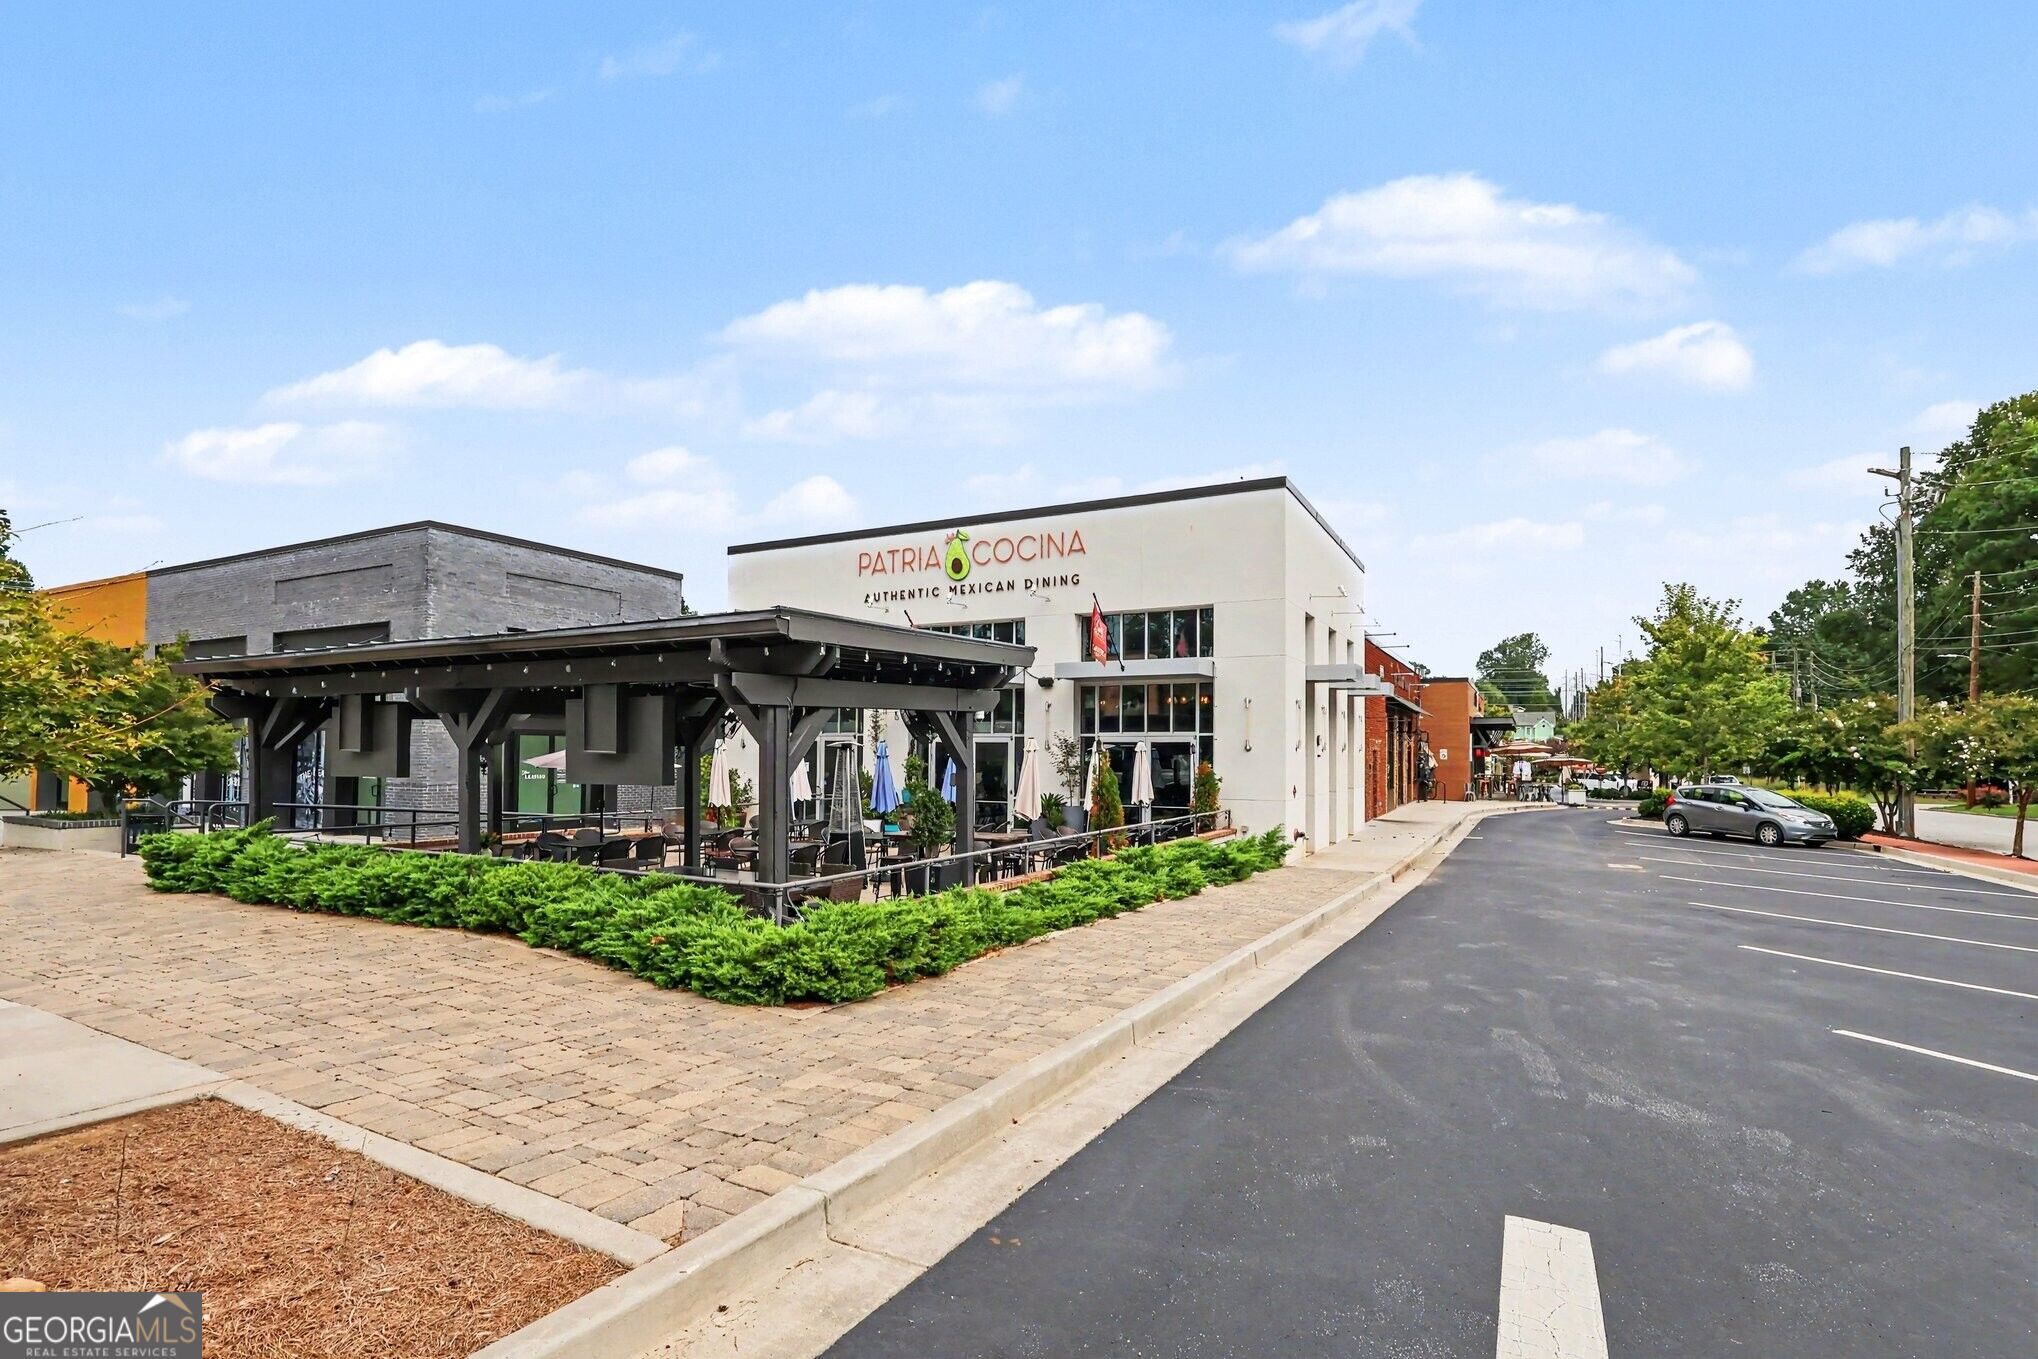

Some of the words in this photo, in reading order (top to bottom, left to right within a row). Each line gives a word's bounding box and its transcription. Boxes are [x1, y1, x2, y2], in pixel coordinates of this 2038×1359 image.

[858, 545, 941, 577] PATRIA
[972, 530, 1086, 566] COCINA
[864, 587, 940, 603] AUTHENTIC
[949, 580, 1015, 596] MEXICAN
[1024, 574, 1080, 590] DINING
